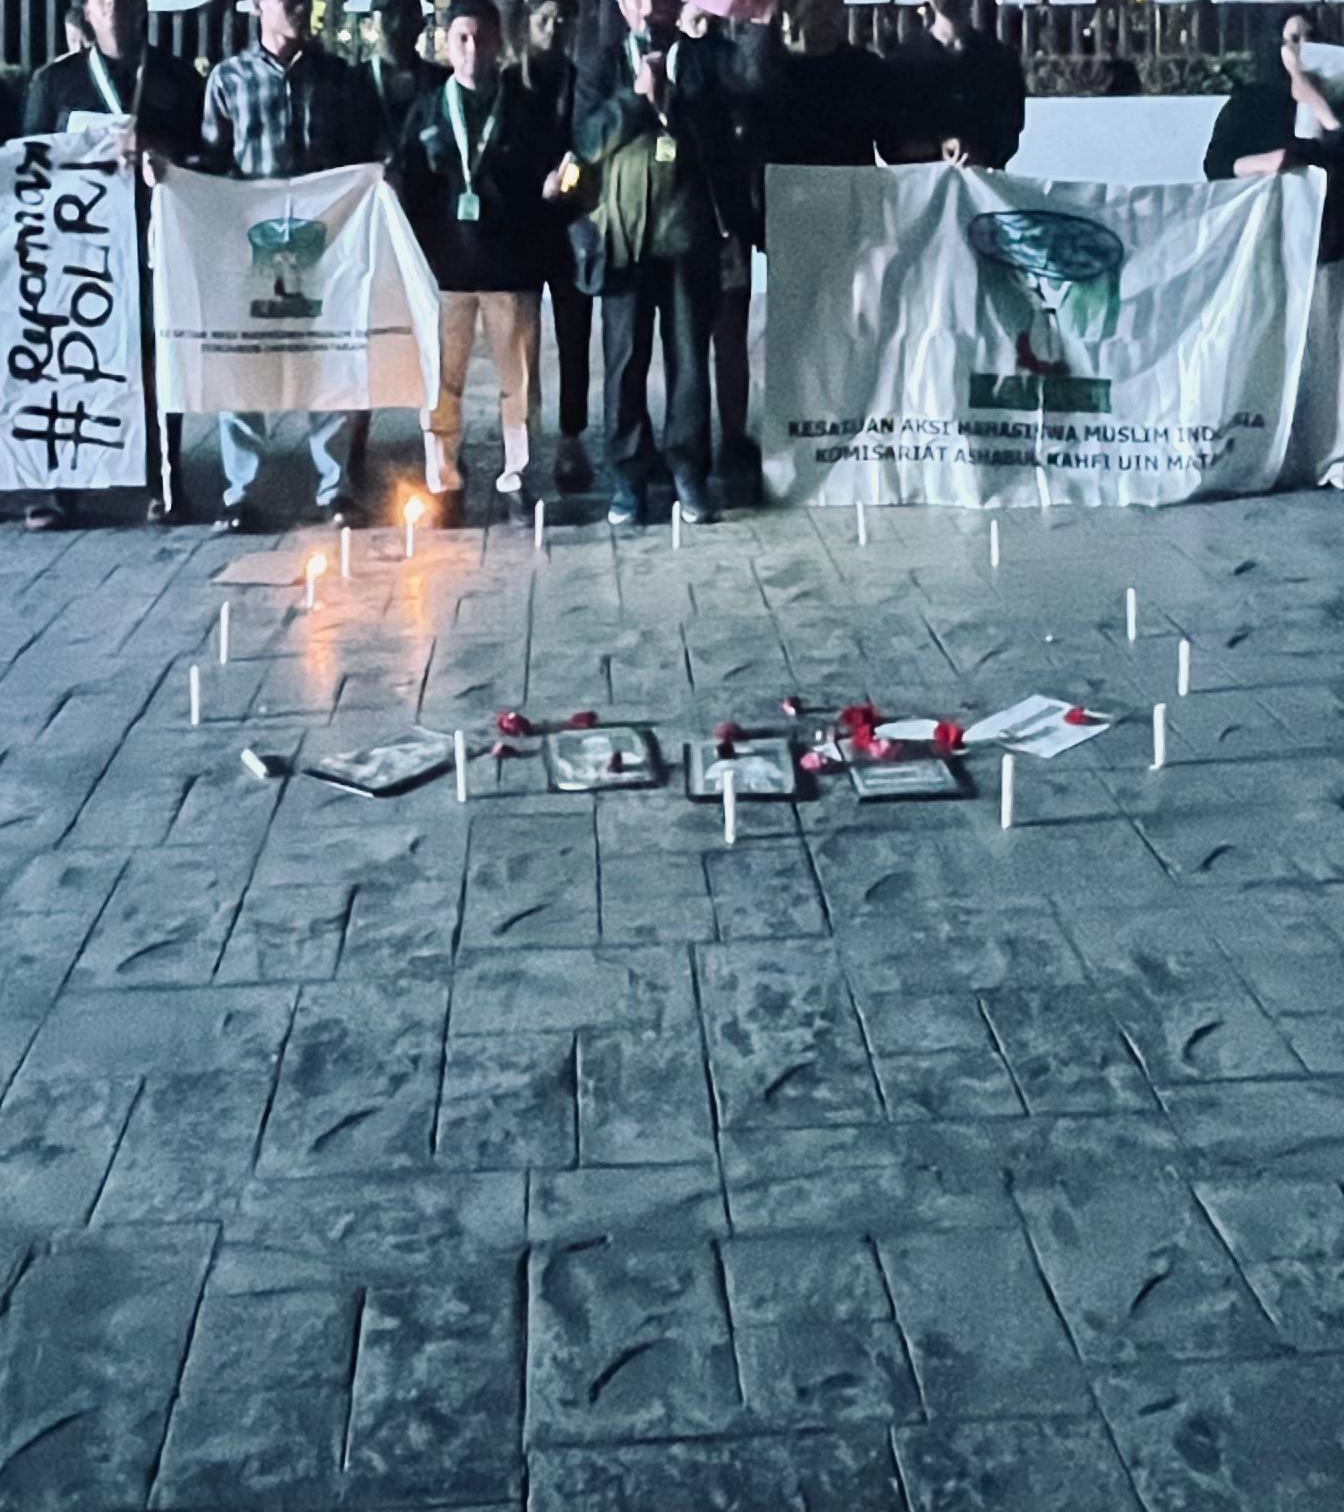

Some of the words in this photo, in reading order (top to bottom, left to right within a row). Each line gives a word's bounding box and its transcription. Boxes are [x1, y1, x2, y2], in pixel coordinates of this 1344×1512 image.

[901, 419, 953, 435] AKSI
[1084, 423, 1169, 443] MUSLIM
[815, 444, 947, 464] KOMISARIAT
[1118, 454, 1159, 471] UIN
